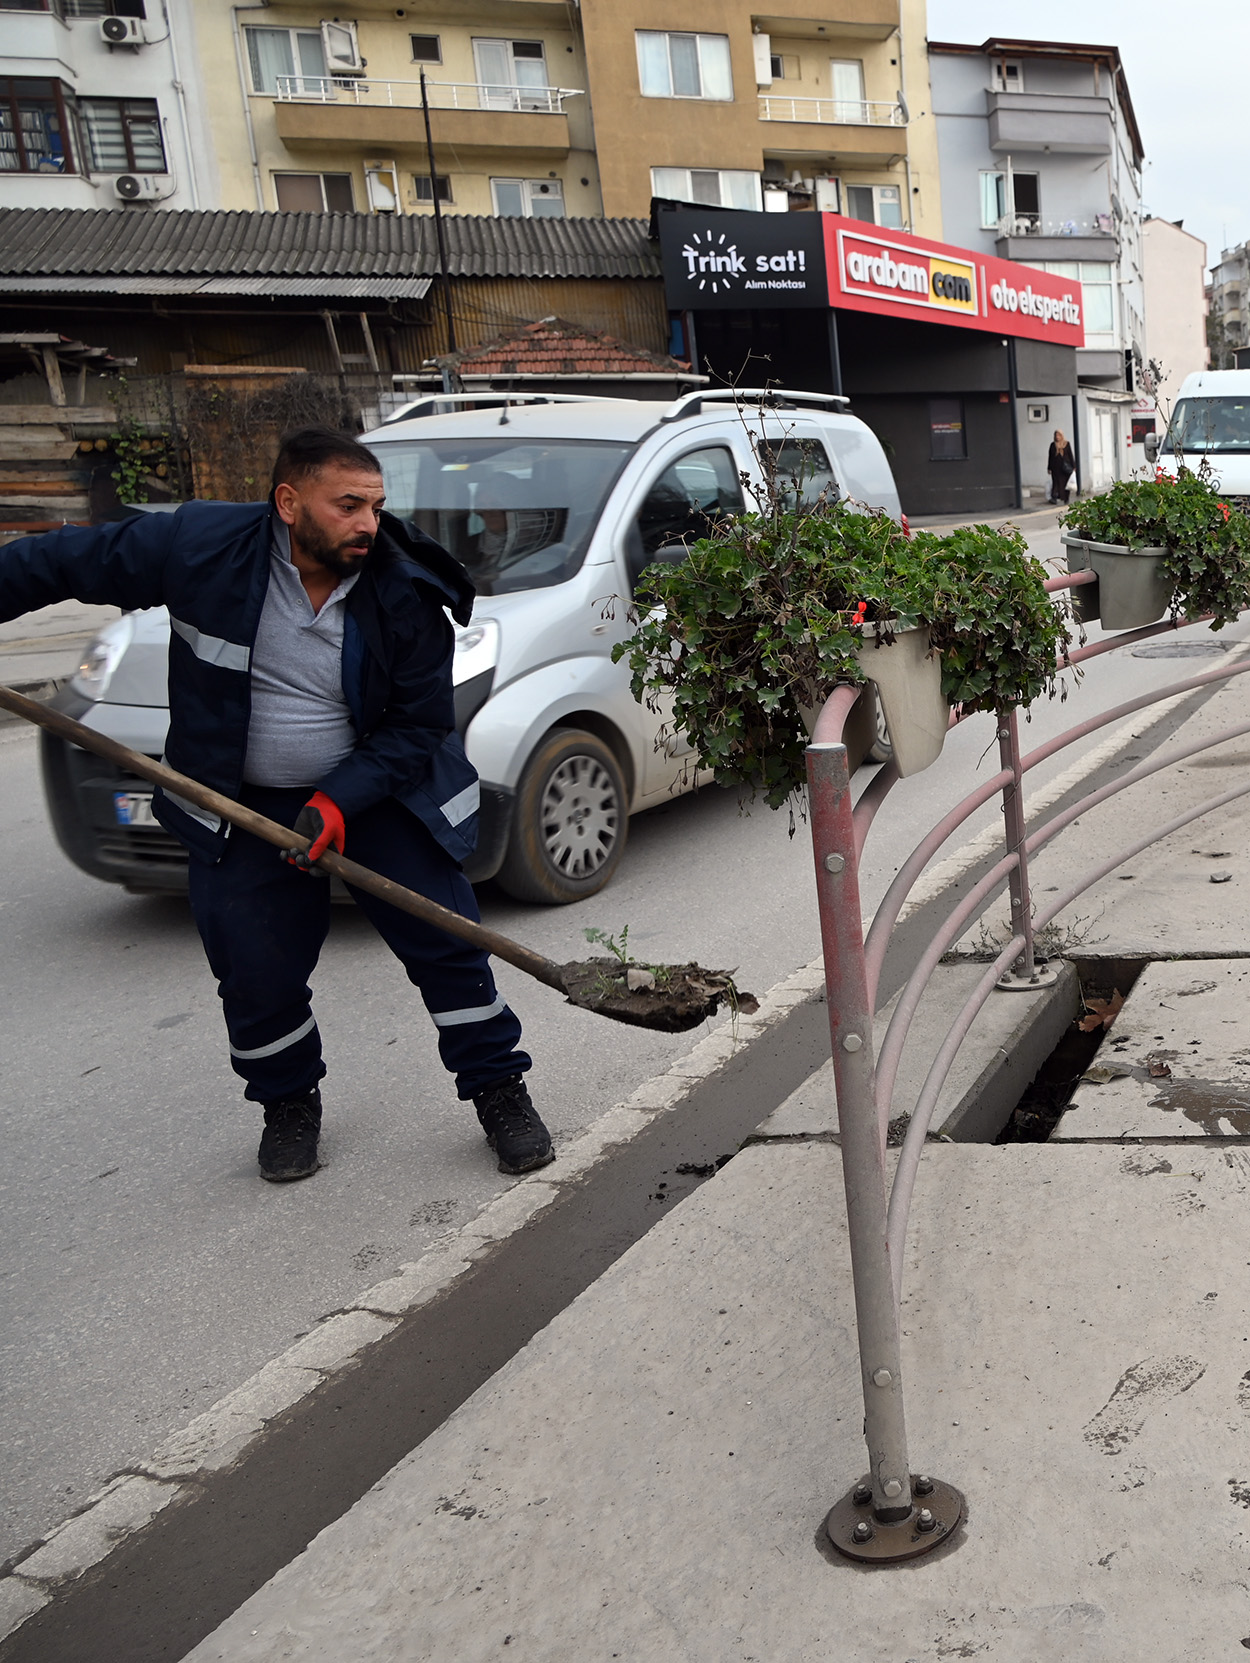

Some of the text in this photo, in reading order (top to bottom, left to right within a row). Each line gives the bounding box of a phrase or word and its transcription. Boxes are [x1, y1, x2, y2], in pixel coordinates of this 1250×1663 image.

[682, 250, 806, 273] Trink sat!
[744, 280, 806, 289] Alım Noktası
[990, 278, 1018, 313] oto
[1018, 284, 1080, 326] ekspertiz
